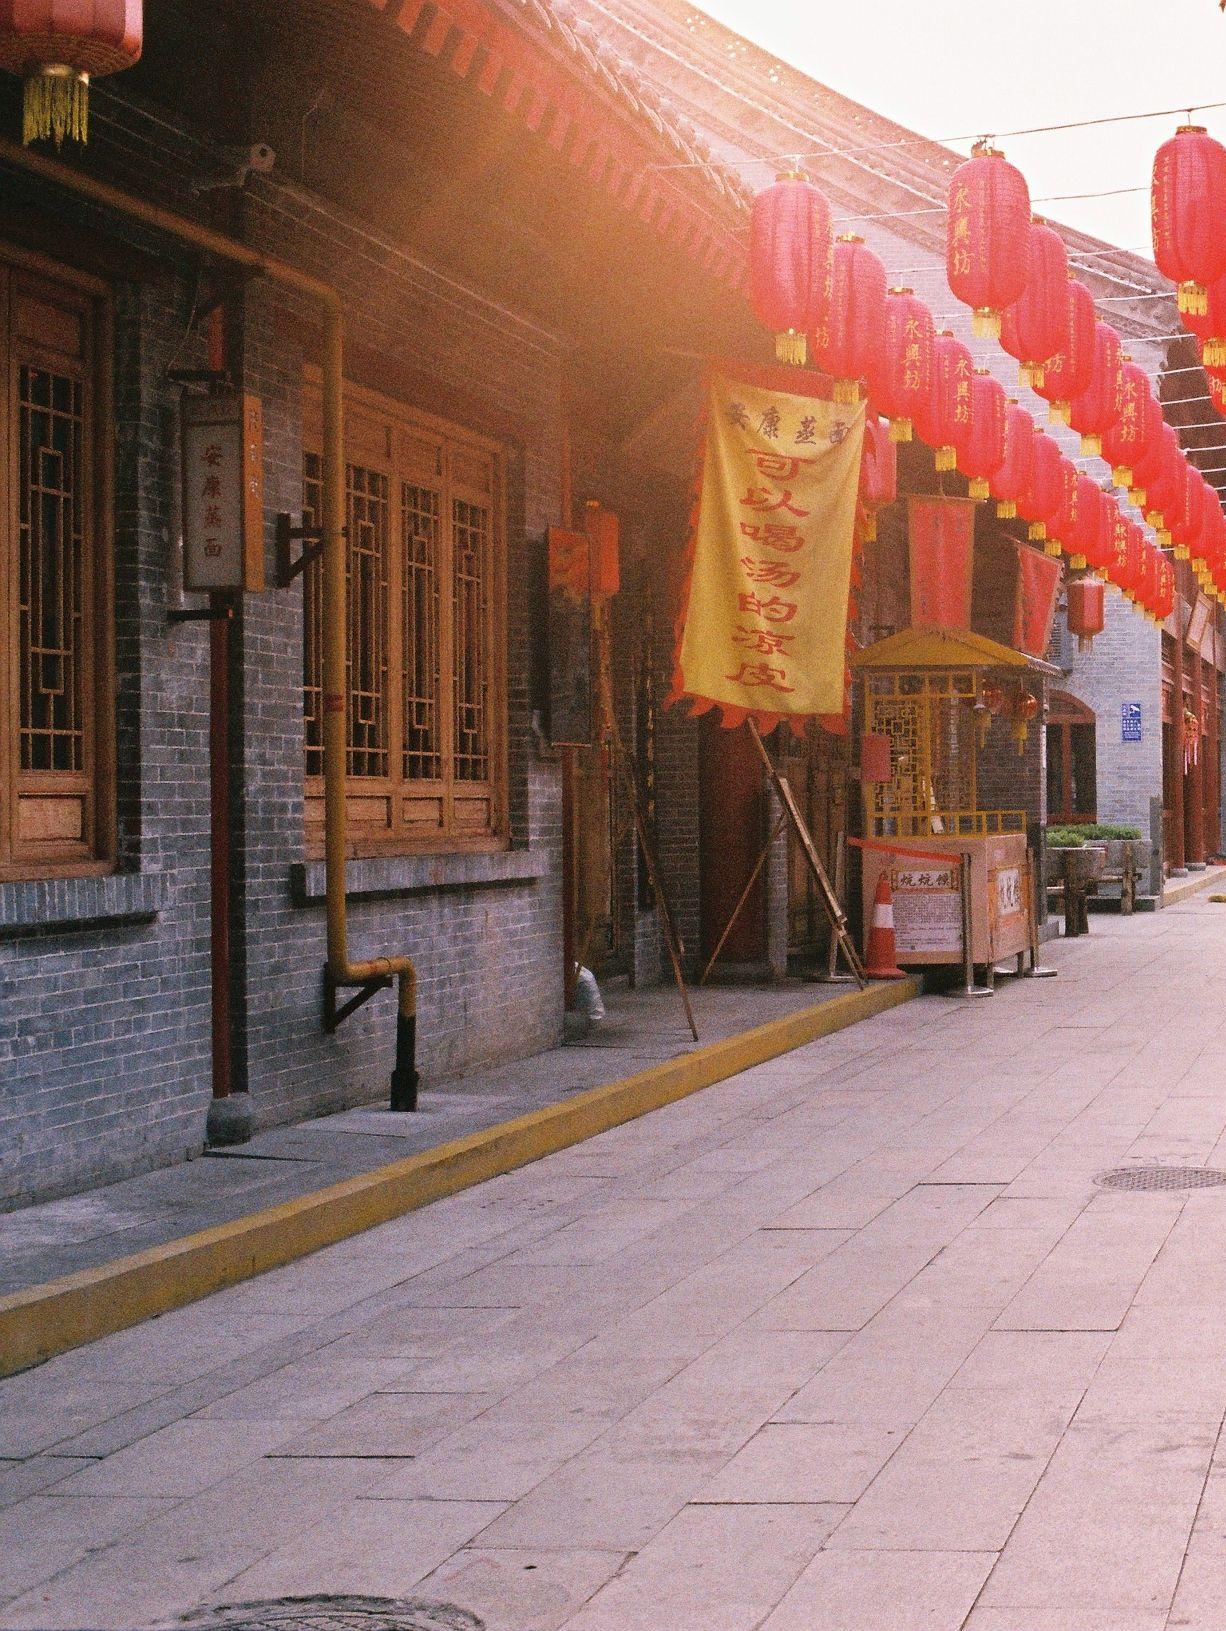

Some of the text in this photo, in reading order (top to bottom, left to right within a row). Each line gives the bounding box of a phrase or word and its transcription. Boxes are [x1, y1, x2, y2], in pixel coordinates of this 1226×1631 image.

[951, 182, 972, 275] 永興坊
[901, 315, 923, 389] 永興坊
[728, 402, 850, 445] 安康蒸面
[954, 355, 972, 424] 永興坊
[1120, 379, 1138, 442] 永興坊
